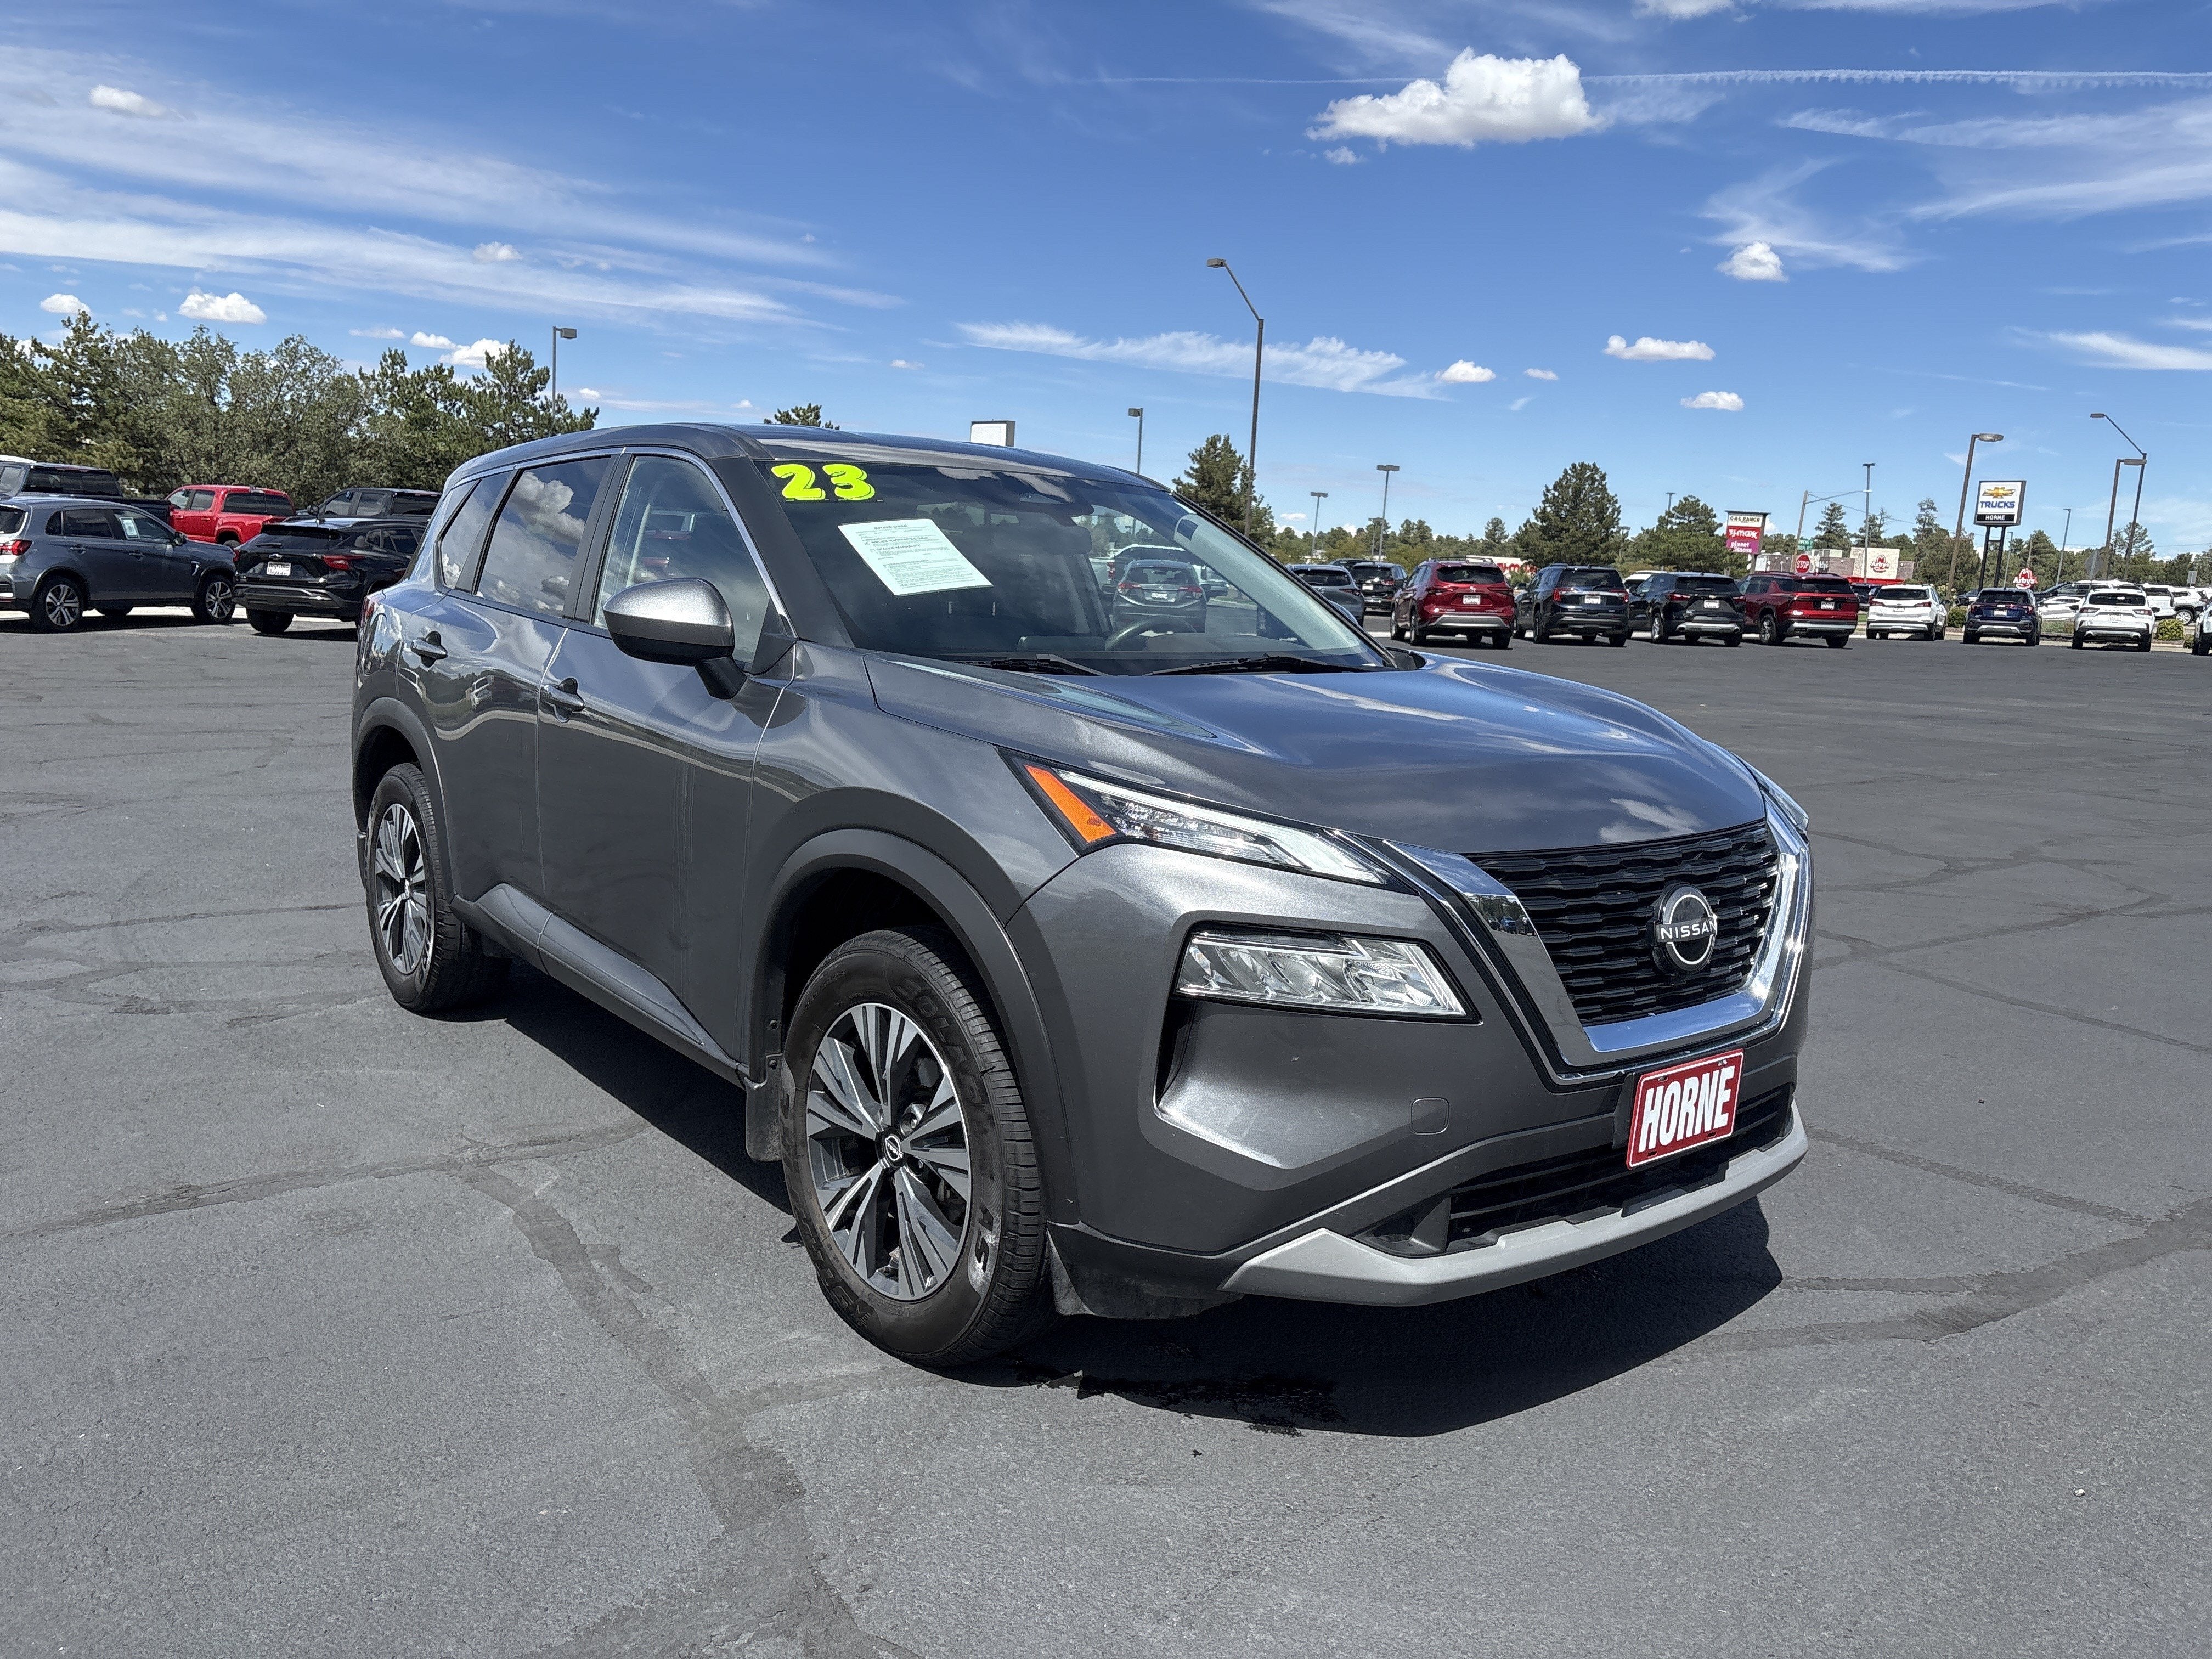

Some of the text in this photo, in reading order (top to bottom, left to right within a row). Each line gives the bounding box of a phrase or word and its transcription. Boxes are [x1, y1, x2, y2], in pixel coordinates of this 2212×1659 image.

[771, 464, 875, 500] 23
[1796, 560, 1809, 569] STOP
[1870, 561, 1889, 569] Arby's
[2013, 577, 2035, 585] Arby's
[1660, 920, 1716, 940] NISSAN
[1638, 1065, 1735, 1153] HORNE
